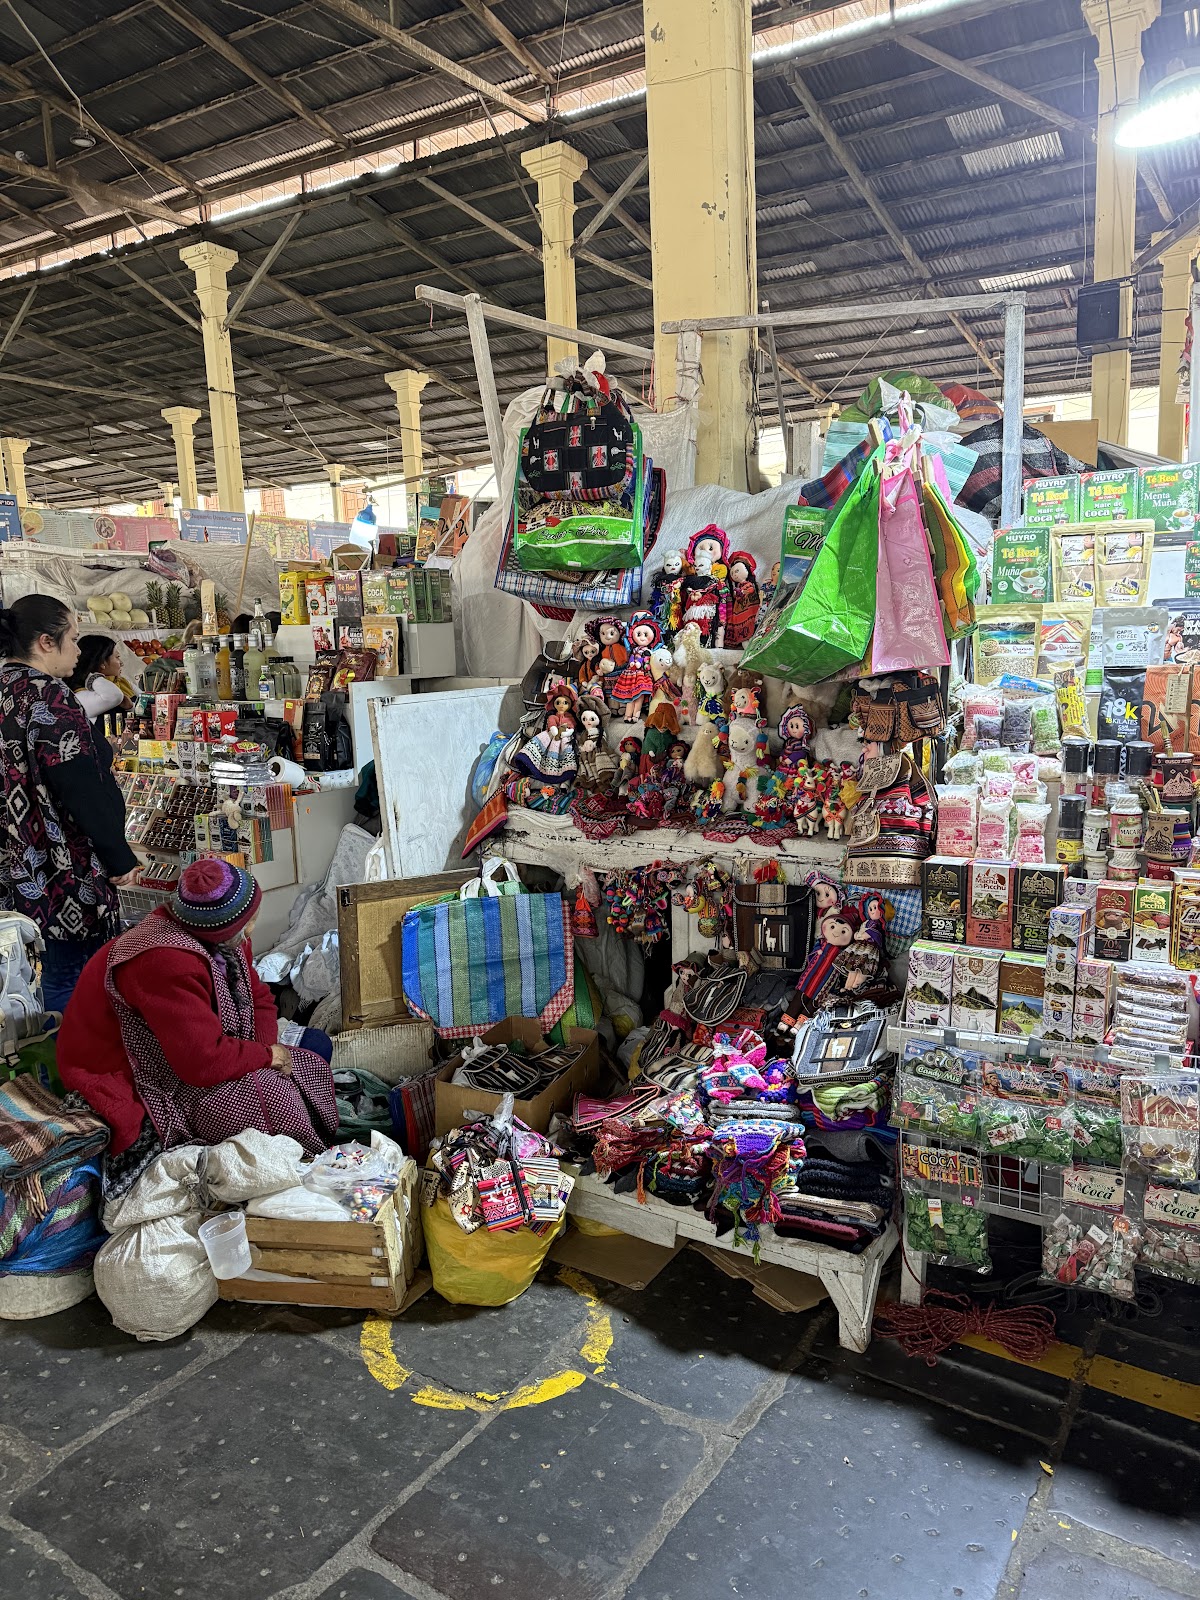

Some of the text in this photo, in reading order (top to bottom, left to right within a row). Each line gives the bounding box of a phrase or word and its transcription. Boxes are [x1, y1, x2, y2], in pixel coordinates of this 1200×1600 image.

[1036, 480, 1066, 488] HUYRO
[1094, 474, 1124, 482] HUYRO
[1146, 473, 1178, 484] Té Real
[1088, 482, 1127, 496] Té Real
[1031, 489, 1068, 502] Té Real
[1152, 499, 1177, 507] Muña
[1001, 546, 1040, 558] Té Real
[997, 566, 1020, 576] Muña
[1103, 940, 1122, 948] 70%
[918, 1066, 960, 1083] Candy Mix
[921, 1154, 956, 1168] COCA
[500, 1174, 516, 1212] CUSCO
[1082, 1185, 1112, 1199] Coca
[1164, 1204, 1197, 1219] Coca
